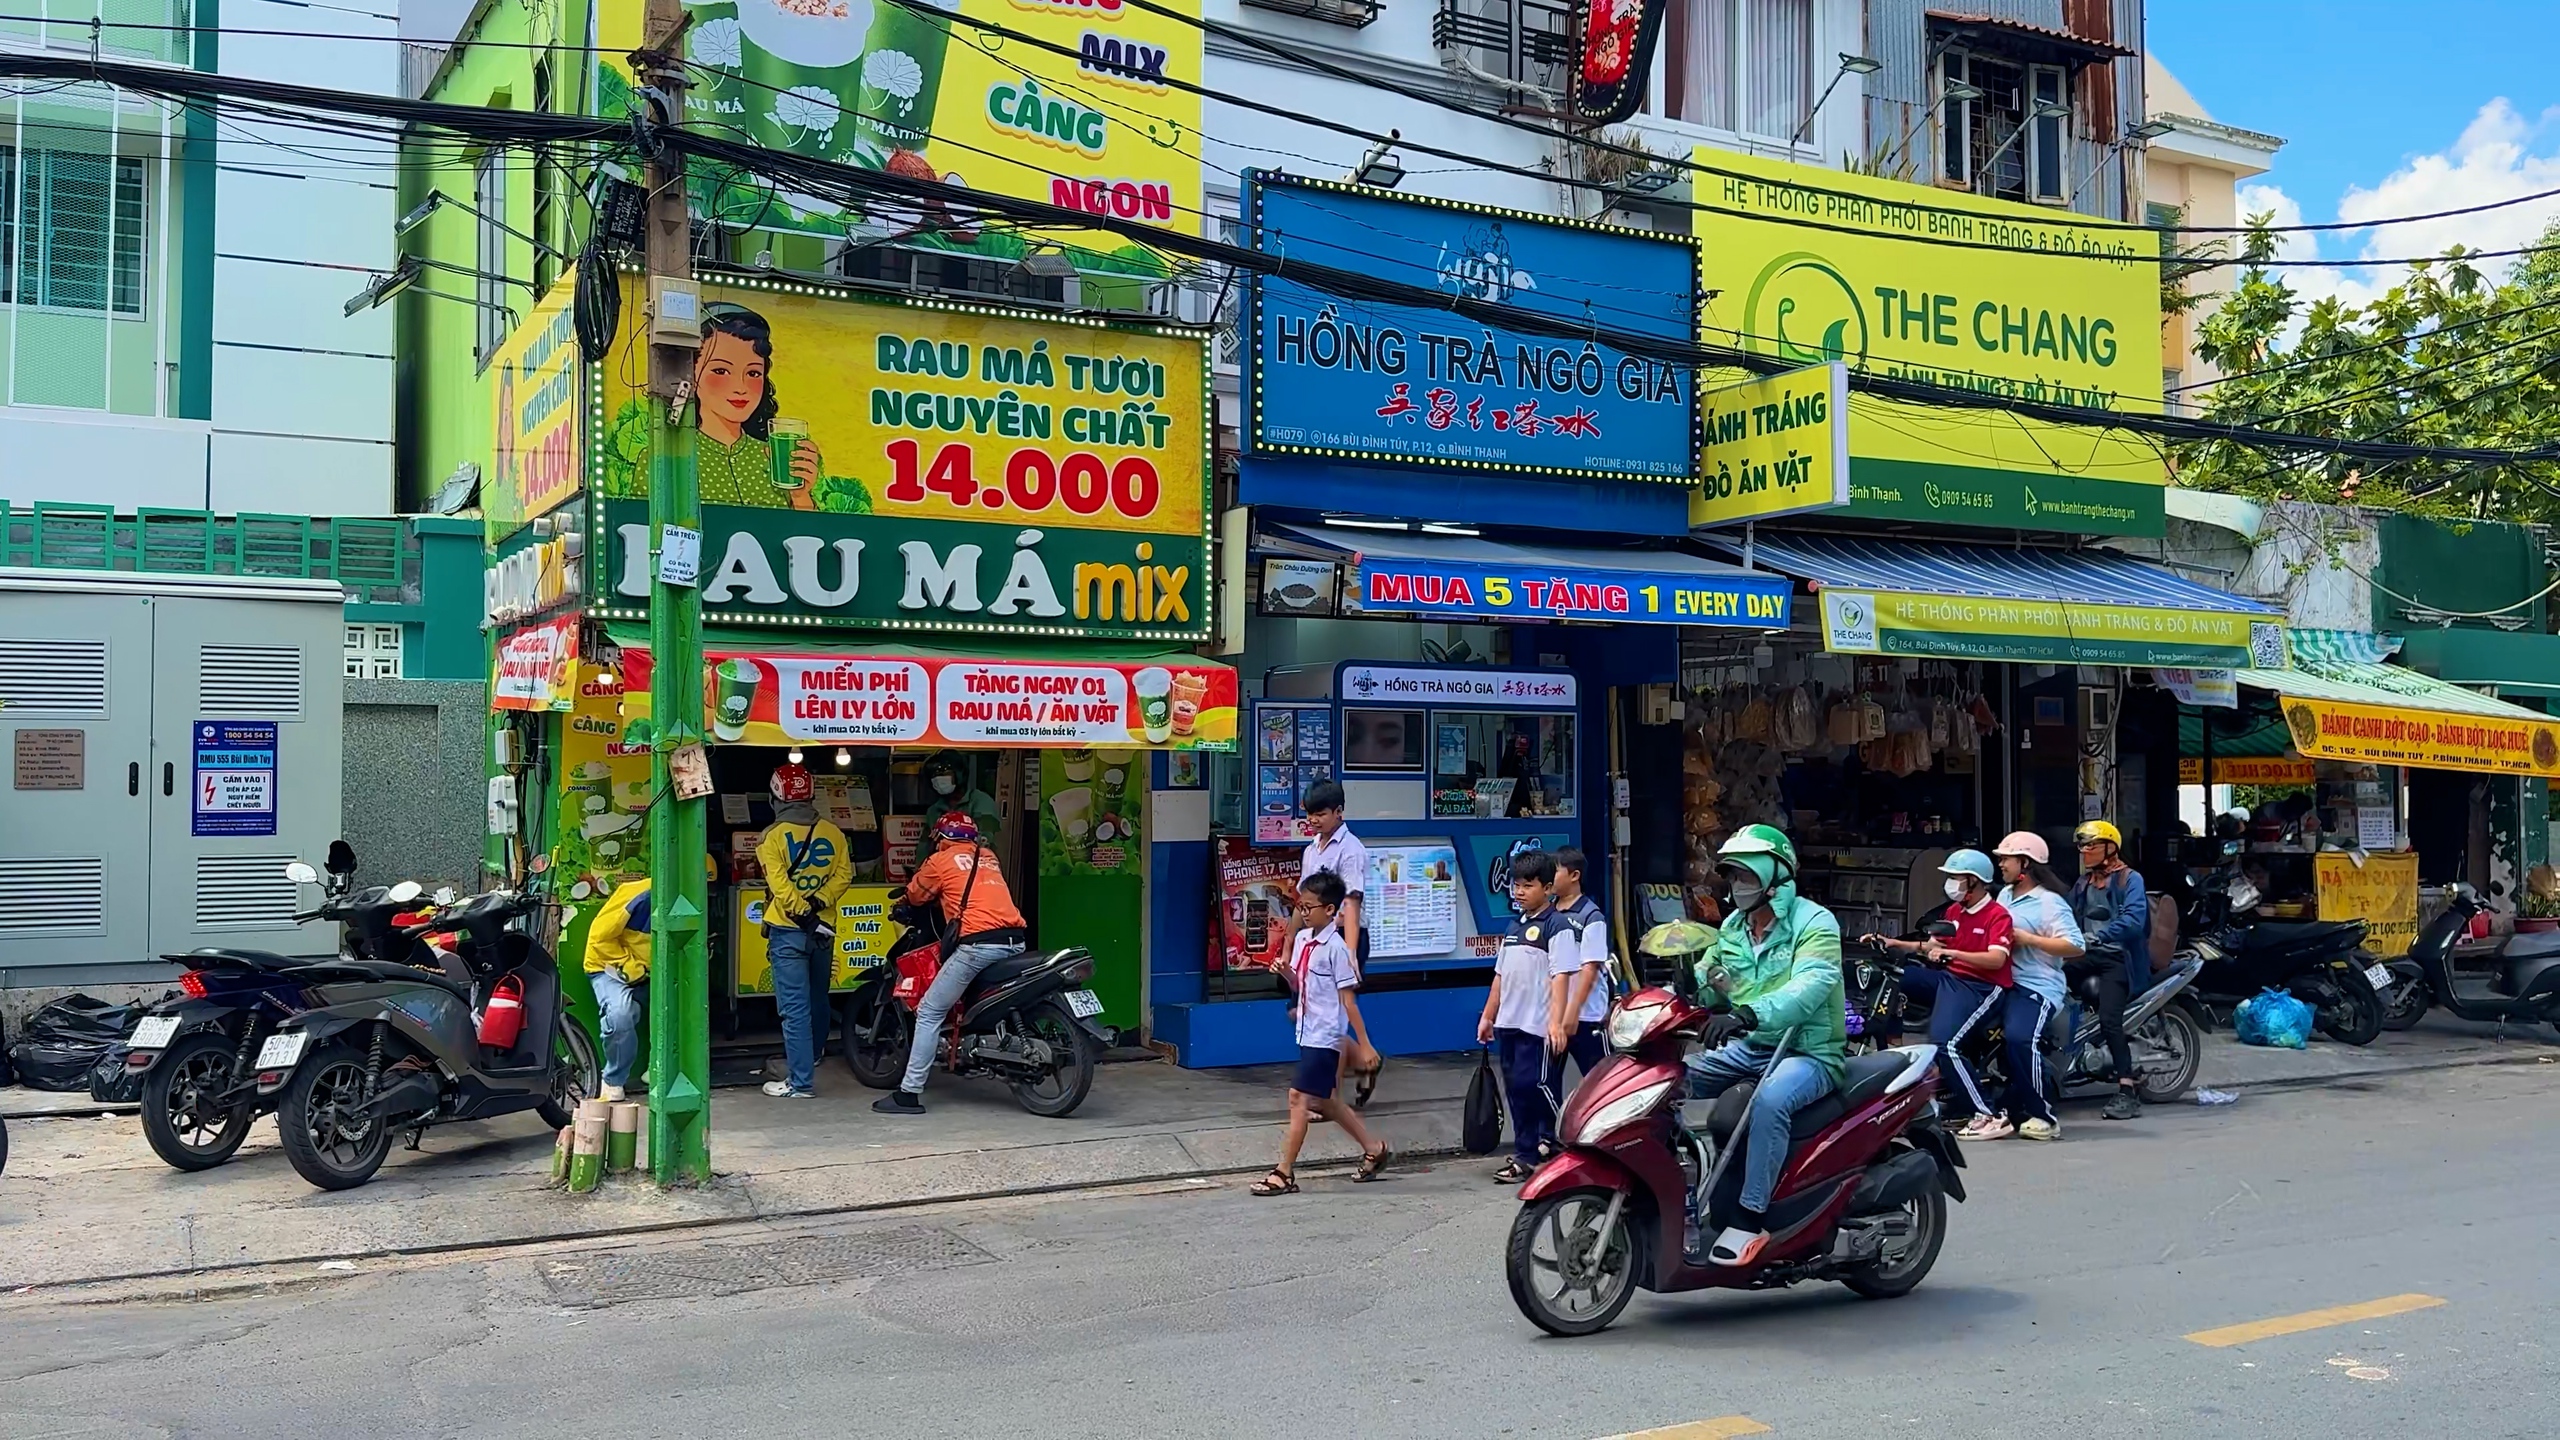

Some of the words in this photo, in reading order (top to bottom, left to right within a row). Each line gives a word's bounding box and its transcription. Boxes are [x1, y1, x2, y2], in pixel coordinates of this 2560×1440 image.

[1081, 34, 1166, 85] MIX
[684, 98, 708, 113] AU
[715, 97, 745, 114] MÁ
[989, 80, 1104, 149] CÀNG
[1052, 179, 1171, 220] NGON
[1874, 286, 1959, 347] THE
[1972, 300, 2118, 368] CHANG
[1275, 301, 1408, 376] HỒNG
[1418, 328, 1506, 389] TRÀ
[1516, 341, 1604, 398] NGÔ
[1615, 354, 1684, 406] GIA
[876, 334, 970, 380] RAU
[981, 339, 1055, 388] MÁ
[1064, 354, 1165, 399] TƯƠI
[521, 378, 551, 438] NGUYÊN
[871, 389, 1051, 440] NGUYÊN
[1062, 401, 1172, 450] CHẤT
[1752, 389, 1826, 438] TRÁNG
[1269, 428, 1304, 442] #H079
[1321, 432, 1340, 445] 166
[1342, 429, 1360, 447] BÙI
[1362, 432, 1389, 449] ĐÌNH
[1412, 440, 1435, 456] P.12,
[1437, 440, 1473, 459] Q.BÌNH
[1474, 446, 1507, 462] THẠNH
[523, 418, 571, 508] 14.000
[1626, 458, 1647, 472] 0931
[1649, 460, 1665, 473] 825
[1667, 461, 1684, 474] 166
[885, 438, 1160, 518] 14.000
[1703, 459, 1733, 501] ĐỒ
[1738, 458, 1767, 495] ĂN
[1773, 449, 1813, 494] VẶT
[1849, 484, 1870, 500] Bình
[1941, 490, 1960, 506] 0909
[1961, 492, 1971, 506] 54
[1972, 493, 1982, 508] 65
[1983, 494, 1994, 508] 85
[2041, 499, 2136, 522] www.banhtrangthechang.vn
[897, 528, 1067, 619] MÁ
[1073, 541, 1190, 623] mix
[1369, 572, 1474, 607] MUA
[1484, 576, 1514, 608] 5
[1521, 576, 1630, 616] TẶNG
[1638, 585, 1661, 615] 1
[1674, 588, 1740, 617] EVERY
[1745, 592, 1786, 620] DAY
[1895, 600, 1915, 622] HỆ
[1919, 600, 1974, 622] THỐNG
[2104, 612, 2151, 632] TRÁNG
[2154, 617, 2164, 632] &
[1833, 629, 1847, 639] THE
[1848, 630, 1873, 641] CHANG
[2081, 649, 2099, 658] 0909
[581, 679, 624, 697] CÀNG
[801, 661, 864, 692] MIỄN
[869, 666, 910, 692] PHÍ
[963, 667, 1021, 697] TẶNG
[1023, 675, 1079, 695] NGAY
[1082, 677, 1107, 696] 01
[1421, 678, 1444, 693] TRÀ
[1446, 679, 1472, 694] NGÔ
[1474, 682, 1494, 695] GIA
[794, 695, 837, 720] LÊN
[842, 699, 868, 720] LY
[872, 697, 916, 721] LỚN
[949, 701, 994, 721] RAU
[997, 696, 1034, 722] MÁ
[1036, 702, 1047, 724] /
[1049, 697, 1081, 723] ĂN
[1083, 697, 1120, 726] VẶT
[572, 715, 617, 735] CÀNG
[812, 724, 827, 734] khi
[828, 726, 848, 734] mua
[849, 725, 861, 734] 02
[862, 725, 870, 736] ly
[871, 722, 886, 735] bất
[985, 726, 999, 736] khi
[999, 728, 1018, 736] mua
[1018, 727, 1030, 736] 03
[1030, 726, 1038, 738] ly
[1038, 725, 1052, 737] lớn
[199, 754, 216, 764] RMU
[217, 754, 230, 764] 555
[222, 774, 242, 783] CẤM
[244, 775, 261, 783] VÀO
[784, 830, 836, 870] be
[1223, 865, 1263, 881] IPHONE
[1263, 863, 1276, 875] 17
[1278, 859, 1301, 873] PRO
[840, 904, 882, 917] THANH
[854, 921, 882, 933] MÁT
[842, 939, 868, 952] GIẢI
[1465, 936, 1497, 948] HOTLINE
[1475, 947, 1497, 957] 0965
[848, 955, 885, 969] NHIỆT
